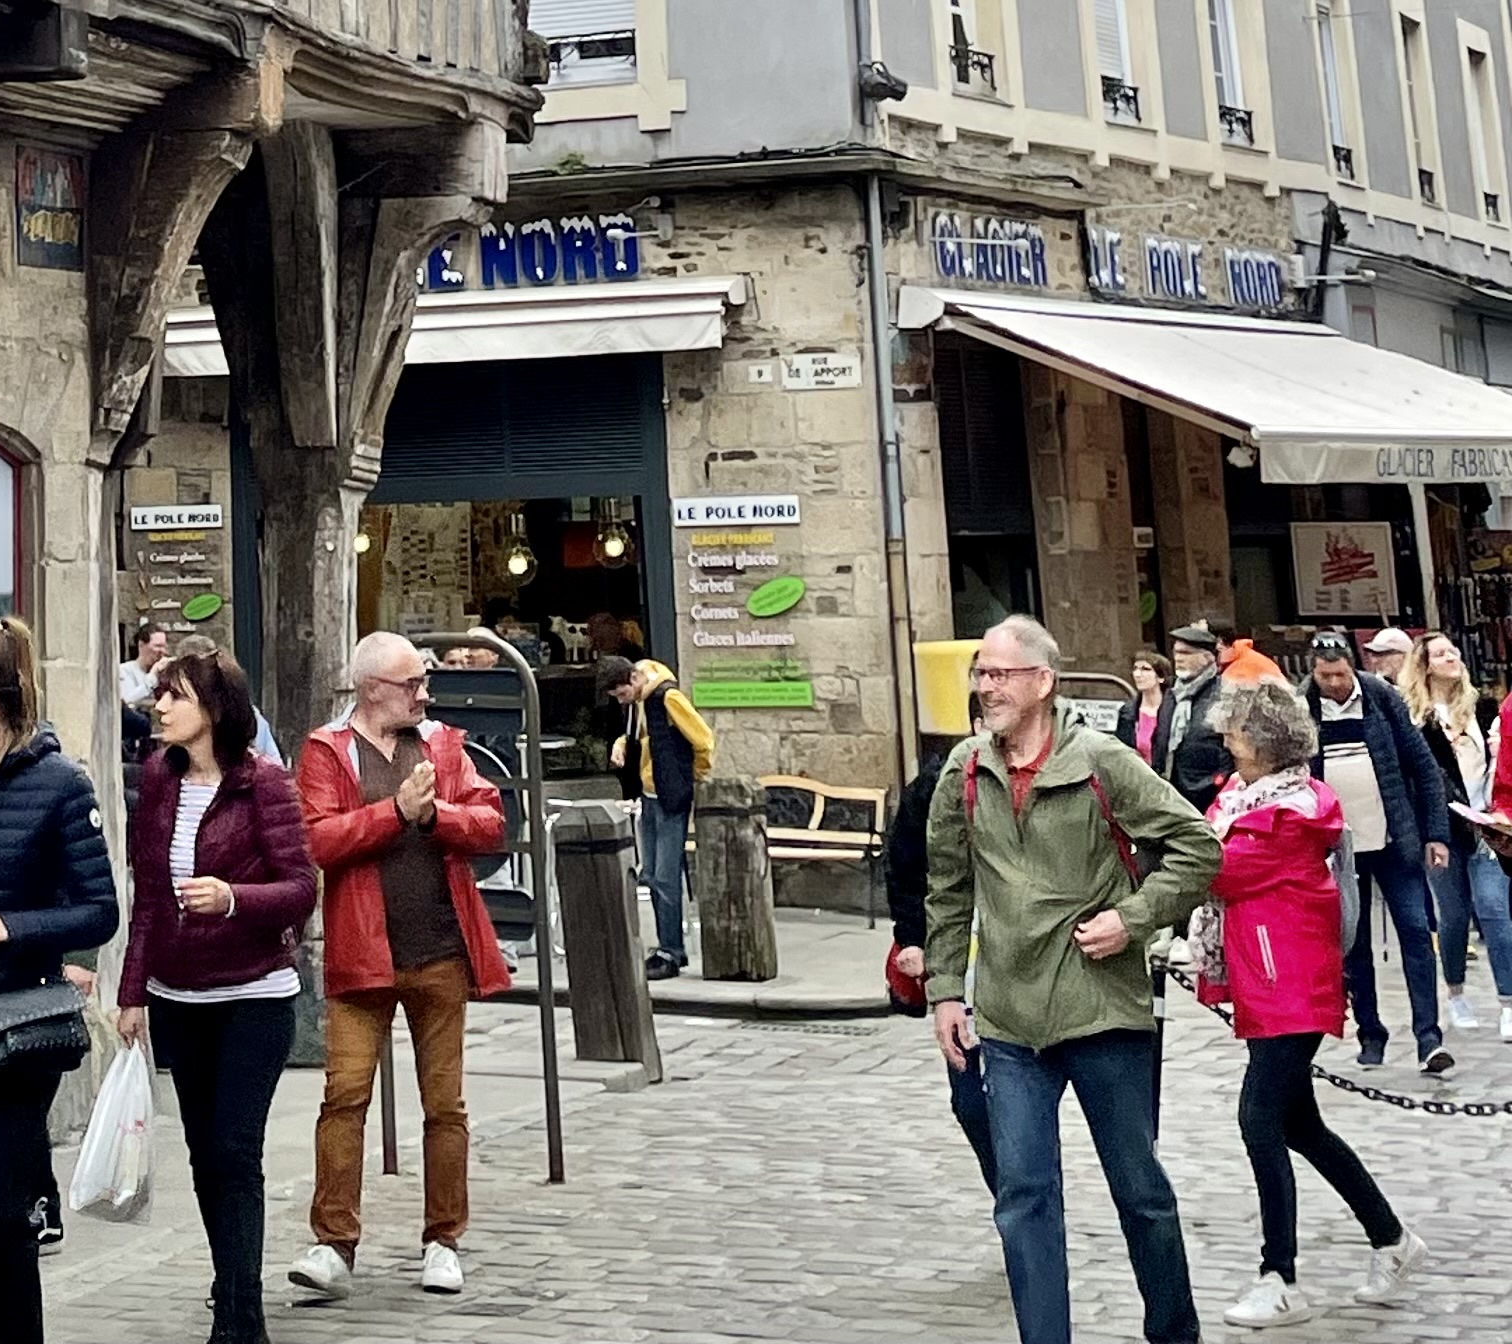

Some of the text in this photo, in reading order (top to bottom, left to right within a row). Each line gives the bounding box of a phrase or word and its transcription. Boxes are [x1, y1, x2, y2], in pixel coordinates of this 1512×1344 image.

[481, 214, 639, 288] NORD
[936, 211, 1048, 286] GLACIER
[1089, 228, 1283, 306] LE POLE NORD
[811, 357, 828, 366] RUE
[1375, 447, 1512, 478] GLACIER FABRICA
[134, 514, 148, 525] LE
[154, 513, 185, 524] POLE
[677, 504, 797, 520] LE POLE NORD
[688, 550, 779, 571] Crèmes glacées
[688, 577, 736, 594] Sorbets
[690, 603, 739, 620] Cornets
[693, 631, 735, 647] Glaces
